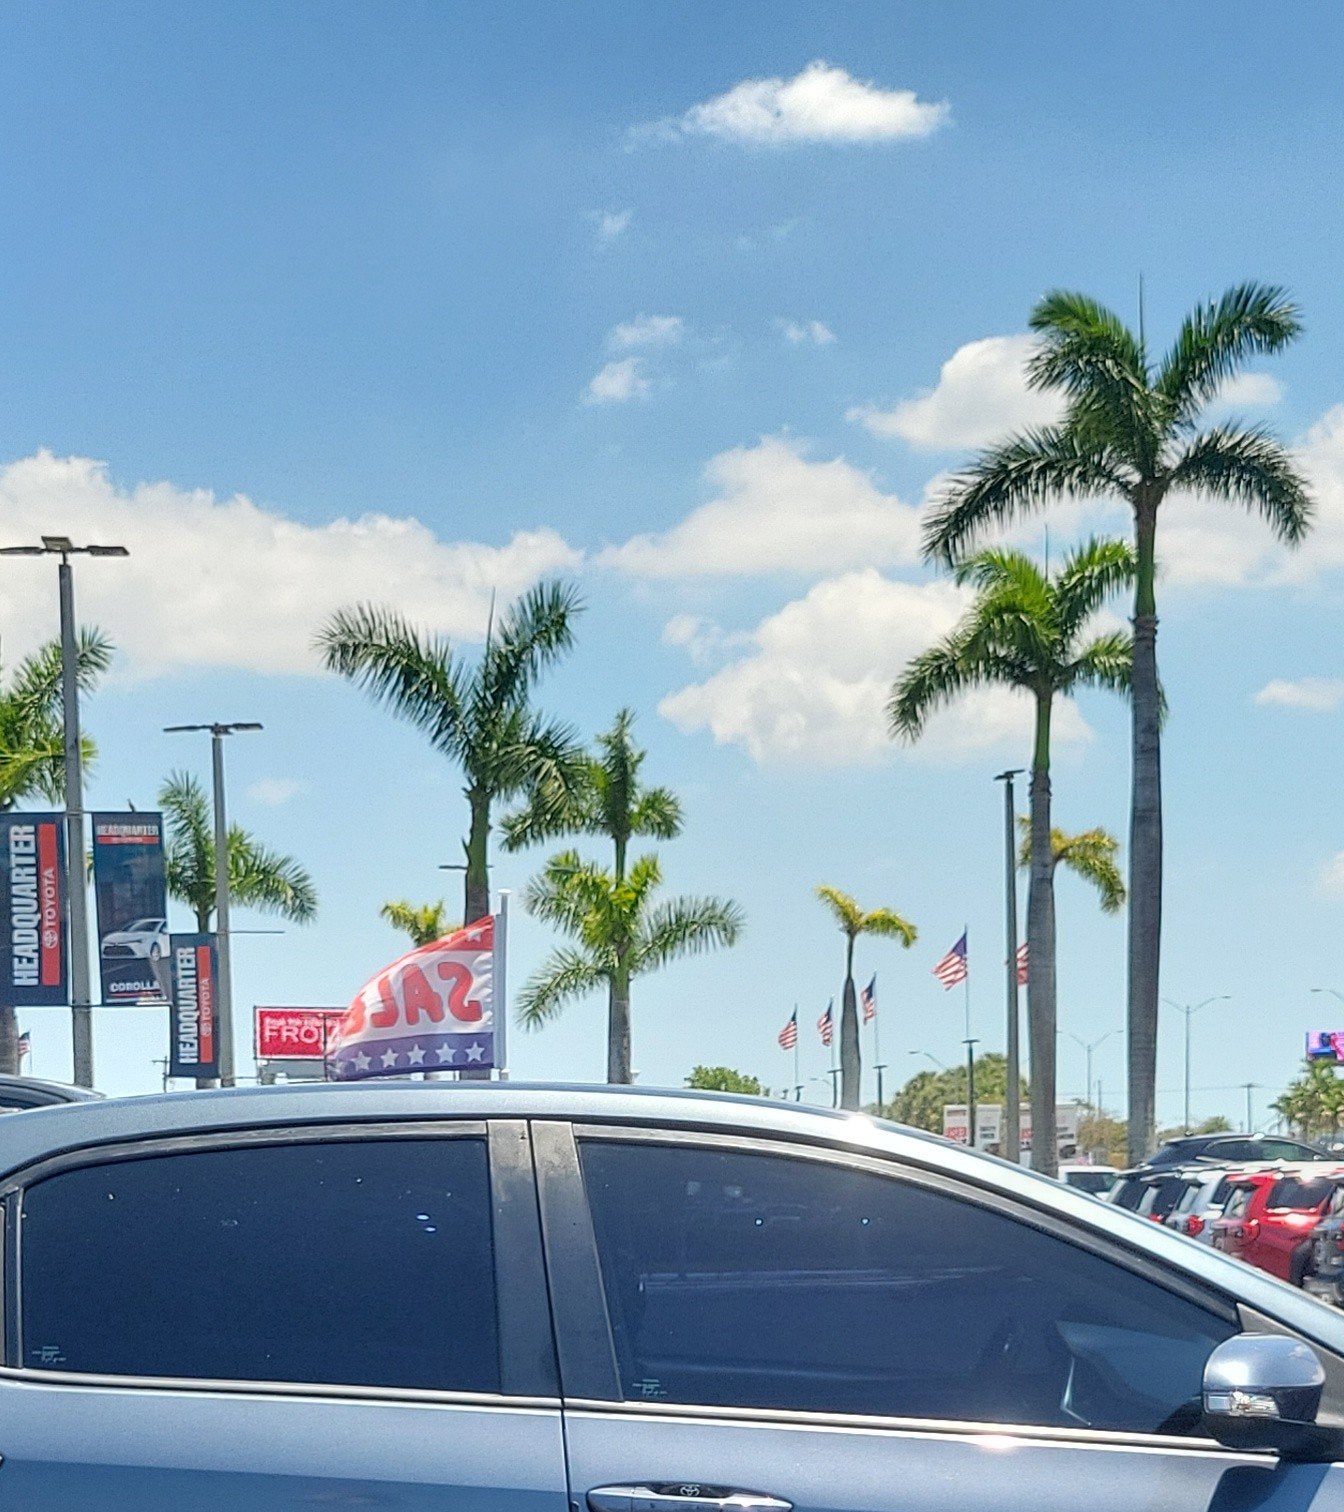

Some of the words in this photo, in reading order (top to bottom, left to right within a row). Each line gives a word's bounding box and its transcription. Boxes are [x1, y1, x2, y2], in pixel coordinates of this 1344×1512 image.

[9, 824, 40, 988] HEADQUARTER
[40, 868, 57, 931] TOYOTA
[175, 946, 199, 1065] HEADQUARTER
[199, 977, 214, 1021] TOYOTA
